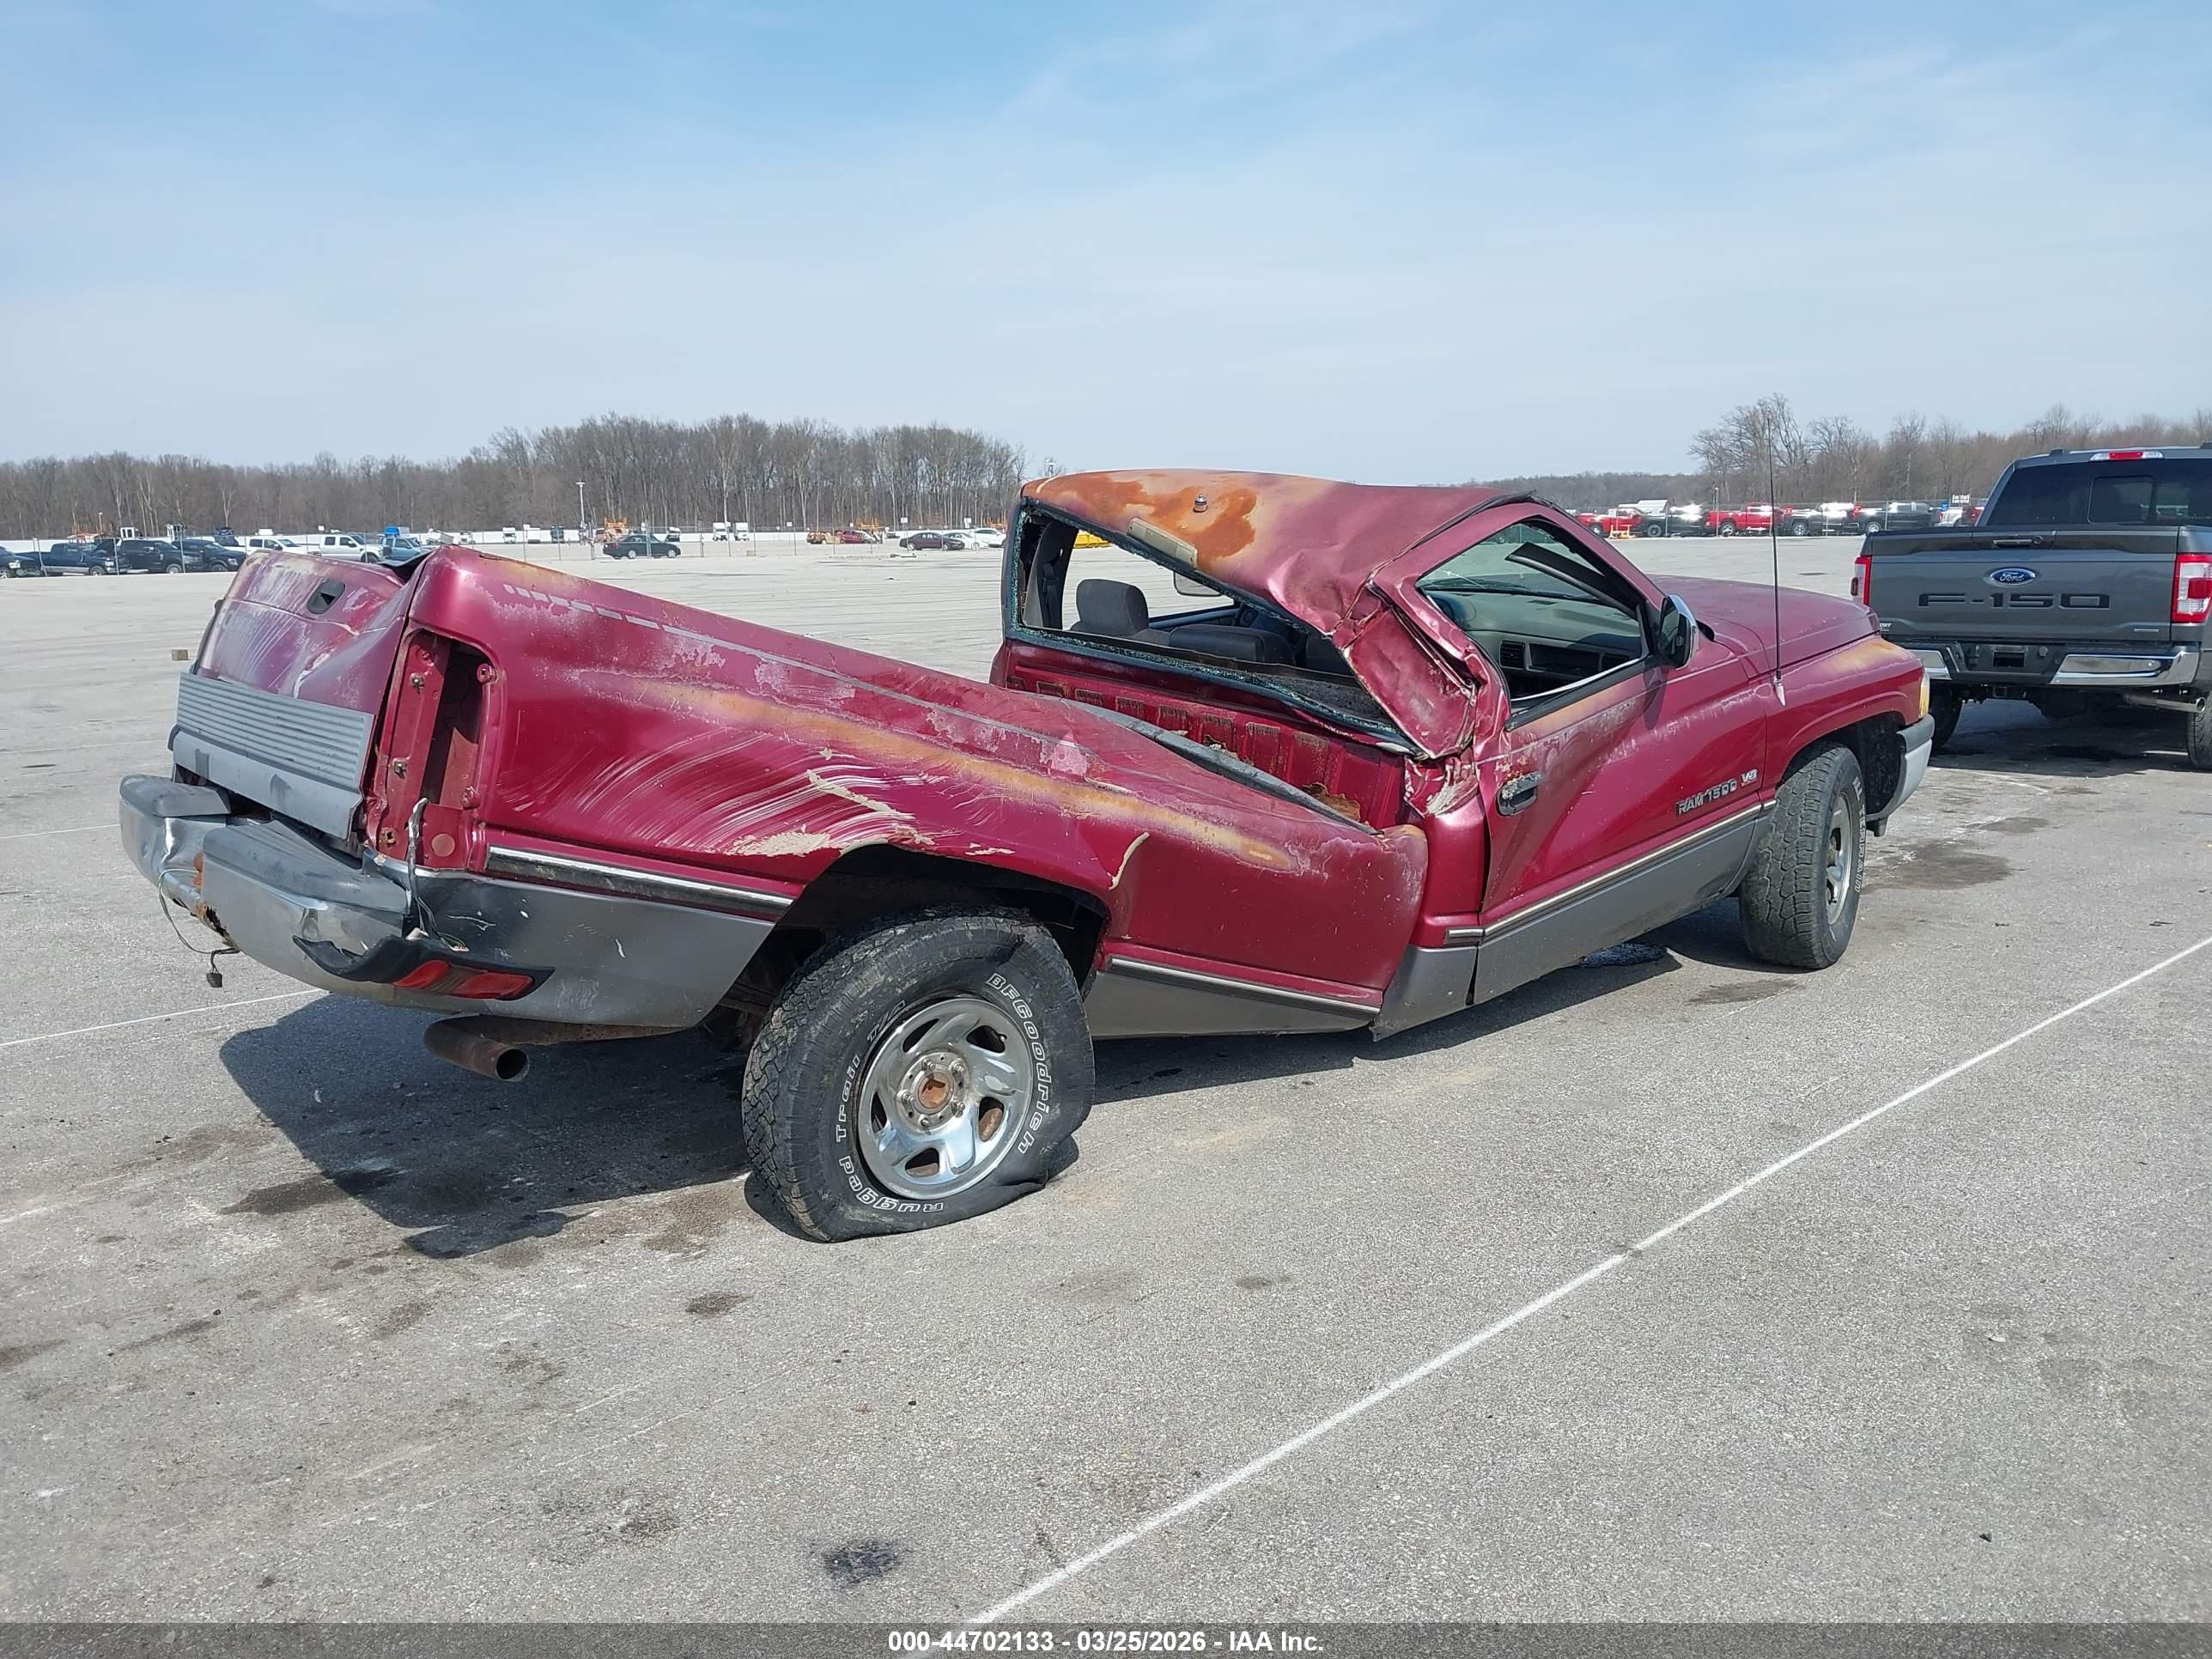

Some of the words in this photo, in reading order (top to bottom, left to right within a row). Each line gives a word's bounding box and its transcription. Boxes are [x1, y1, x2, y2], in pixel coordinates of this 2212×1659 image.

[1917, 592, 2110, 611] F-150
[1676, 793, 1705, 817] RAM
[1706, 778, 1737, 802] 1500
[1741, 769, 1759, 787] V8
[985, 973, 1052, 1154] BFGoodrich
[836, 1054, 861, 1143] Trail
[838, 1155, 945, 1212] Rugged
